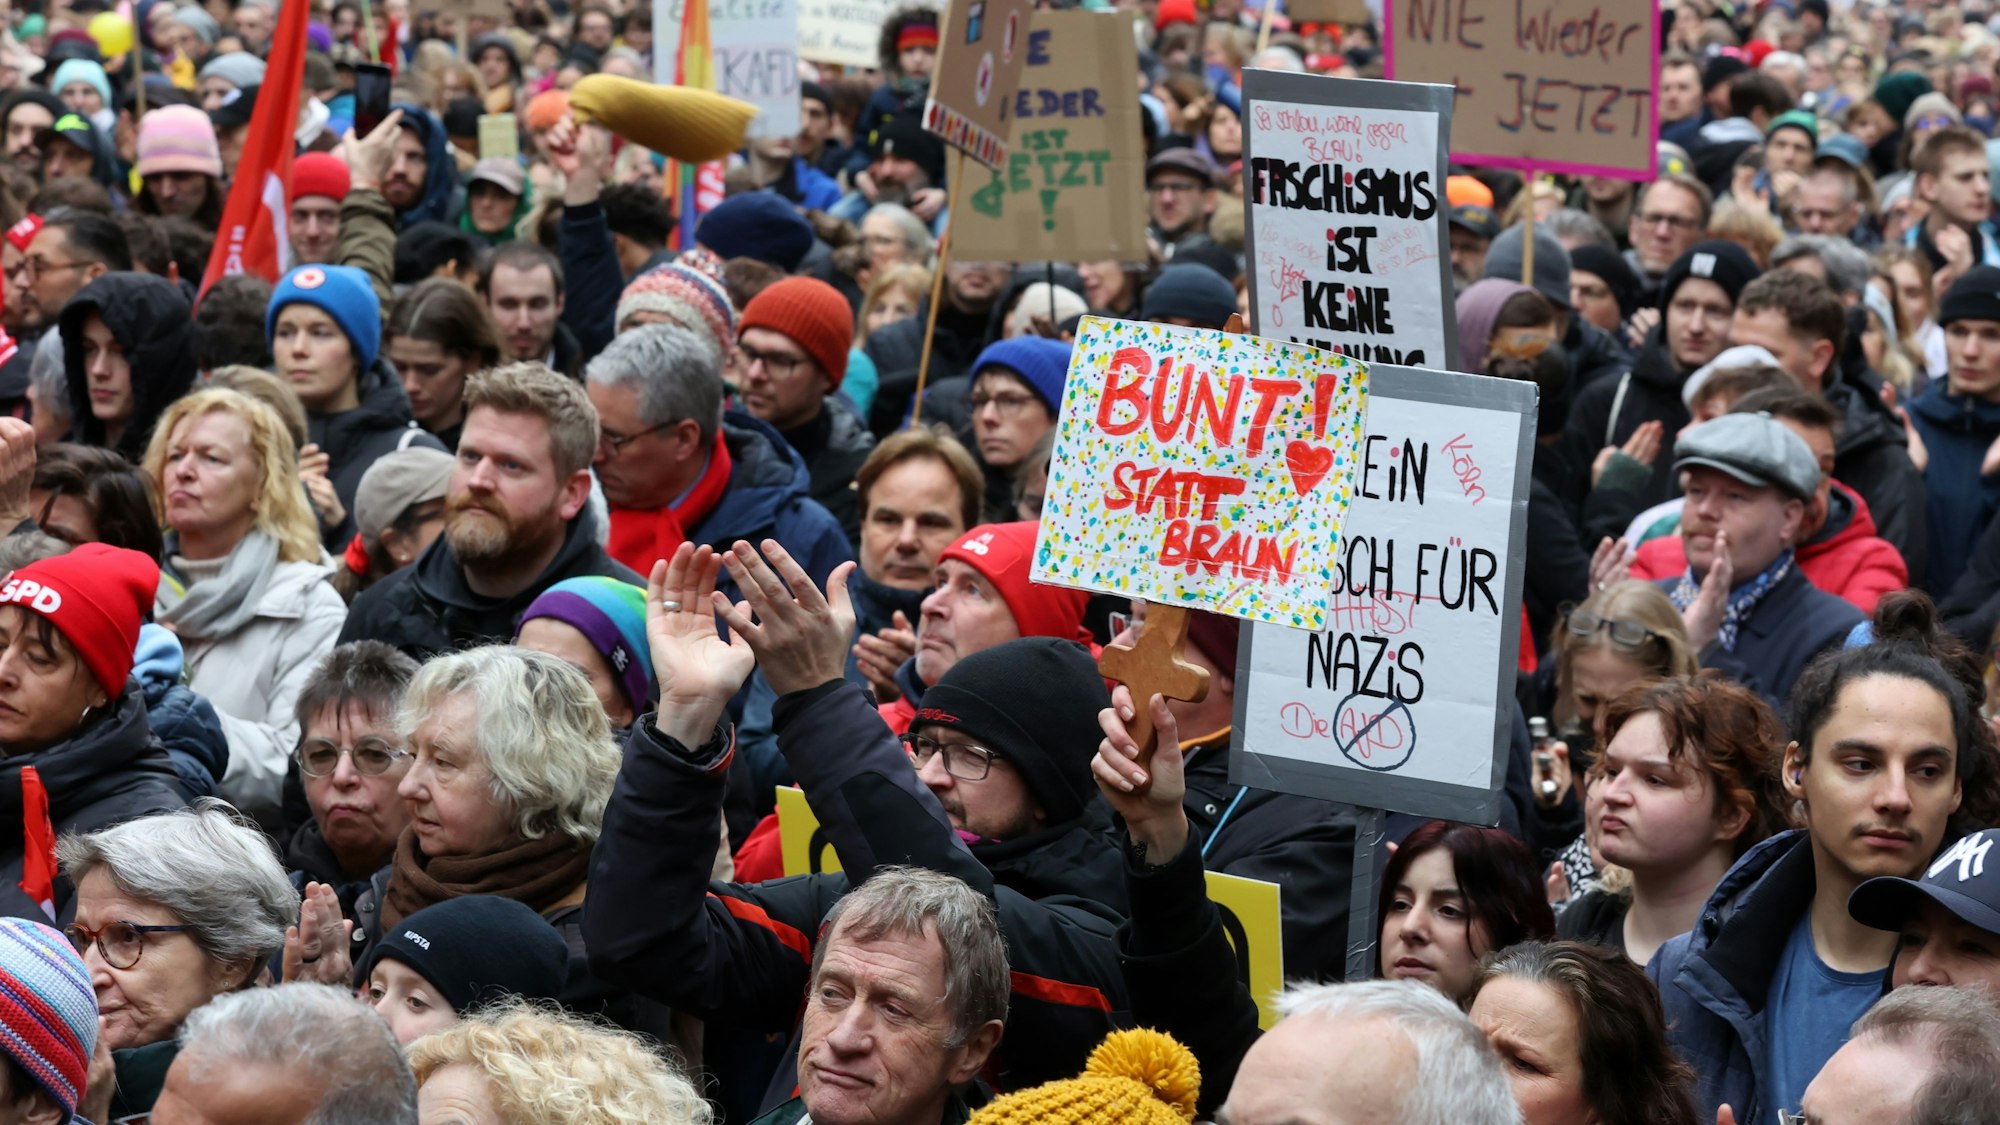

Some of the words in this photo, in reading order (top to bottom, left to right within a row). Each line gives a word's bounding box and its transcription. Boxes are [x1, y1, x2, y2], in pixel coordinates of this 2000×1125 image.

[1027, 30, 1051, 66] E
[1405, 0, 1484, 49] NIE
[713, 47, 797, 96] KAFD
[1014, 88, 1105, 118] EDER
[1497, 73, 1653, 137] JETZT
[1302, 136, 1364, 164] BLAU!
[1096, 346, 1338, 459] BUNT!
[1103, 460, 1247, 521] STATT
[1354, 434, 1429, 506] EiN
[1158, 518, 1300, 586] BRAUN
[1331, 535, 1394, 601] SCH
[1415, 536, 1499, 616] FÜR
[0, 578, 62, 614] SPD
[1280, 701, 1330, 739] Die
[403, 929, 432, 951] KIPSTA
